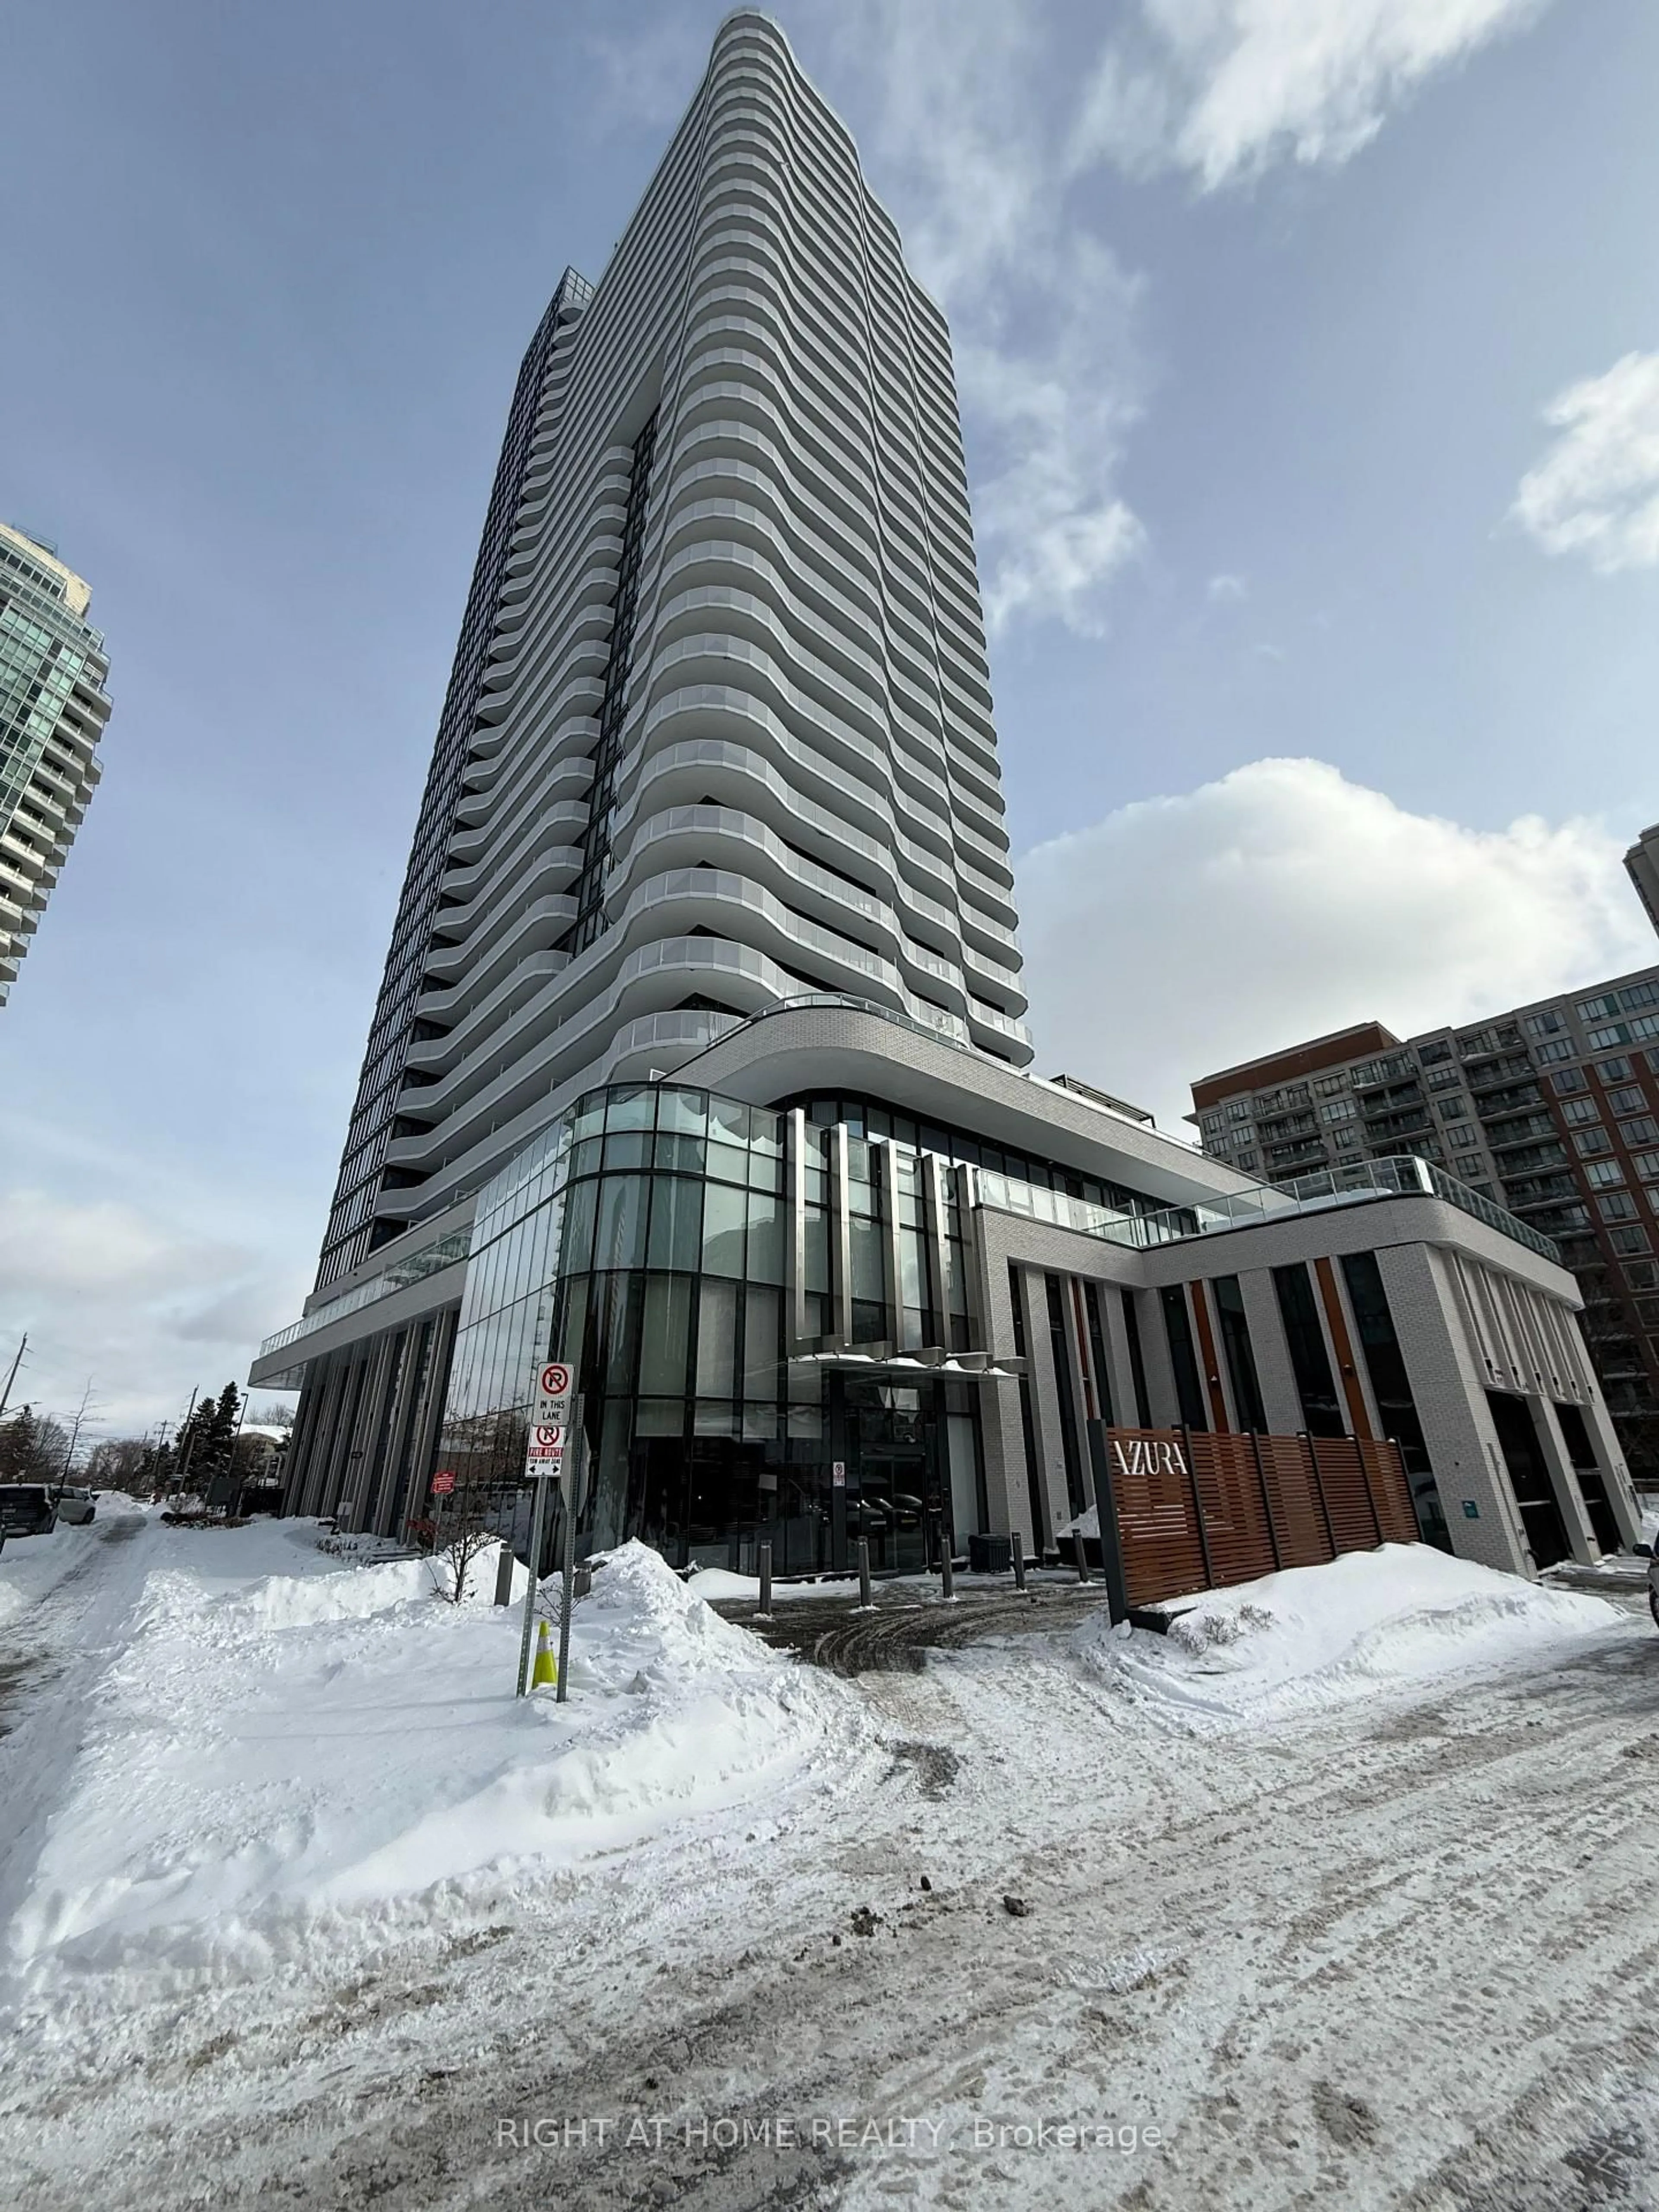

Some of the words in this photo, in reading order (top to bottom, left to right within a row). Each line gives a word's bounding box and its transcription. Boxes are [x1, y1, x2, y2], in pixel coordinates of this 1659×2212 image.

[540, 1400, 547, 1408] IN
[551, 1400, 565, 1408] THIS
[542, 1411, 561, 1420] LANE
[1112, 1440, 1189, 1475] AZURA
